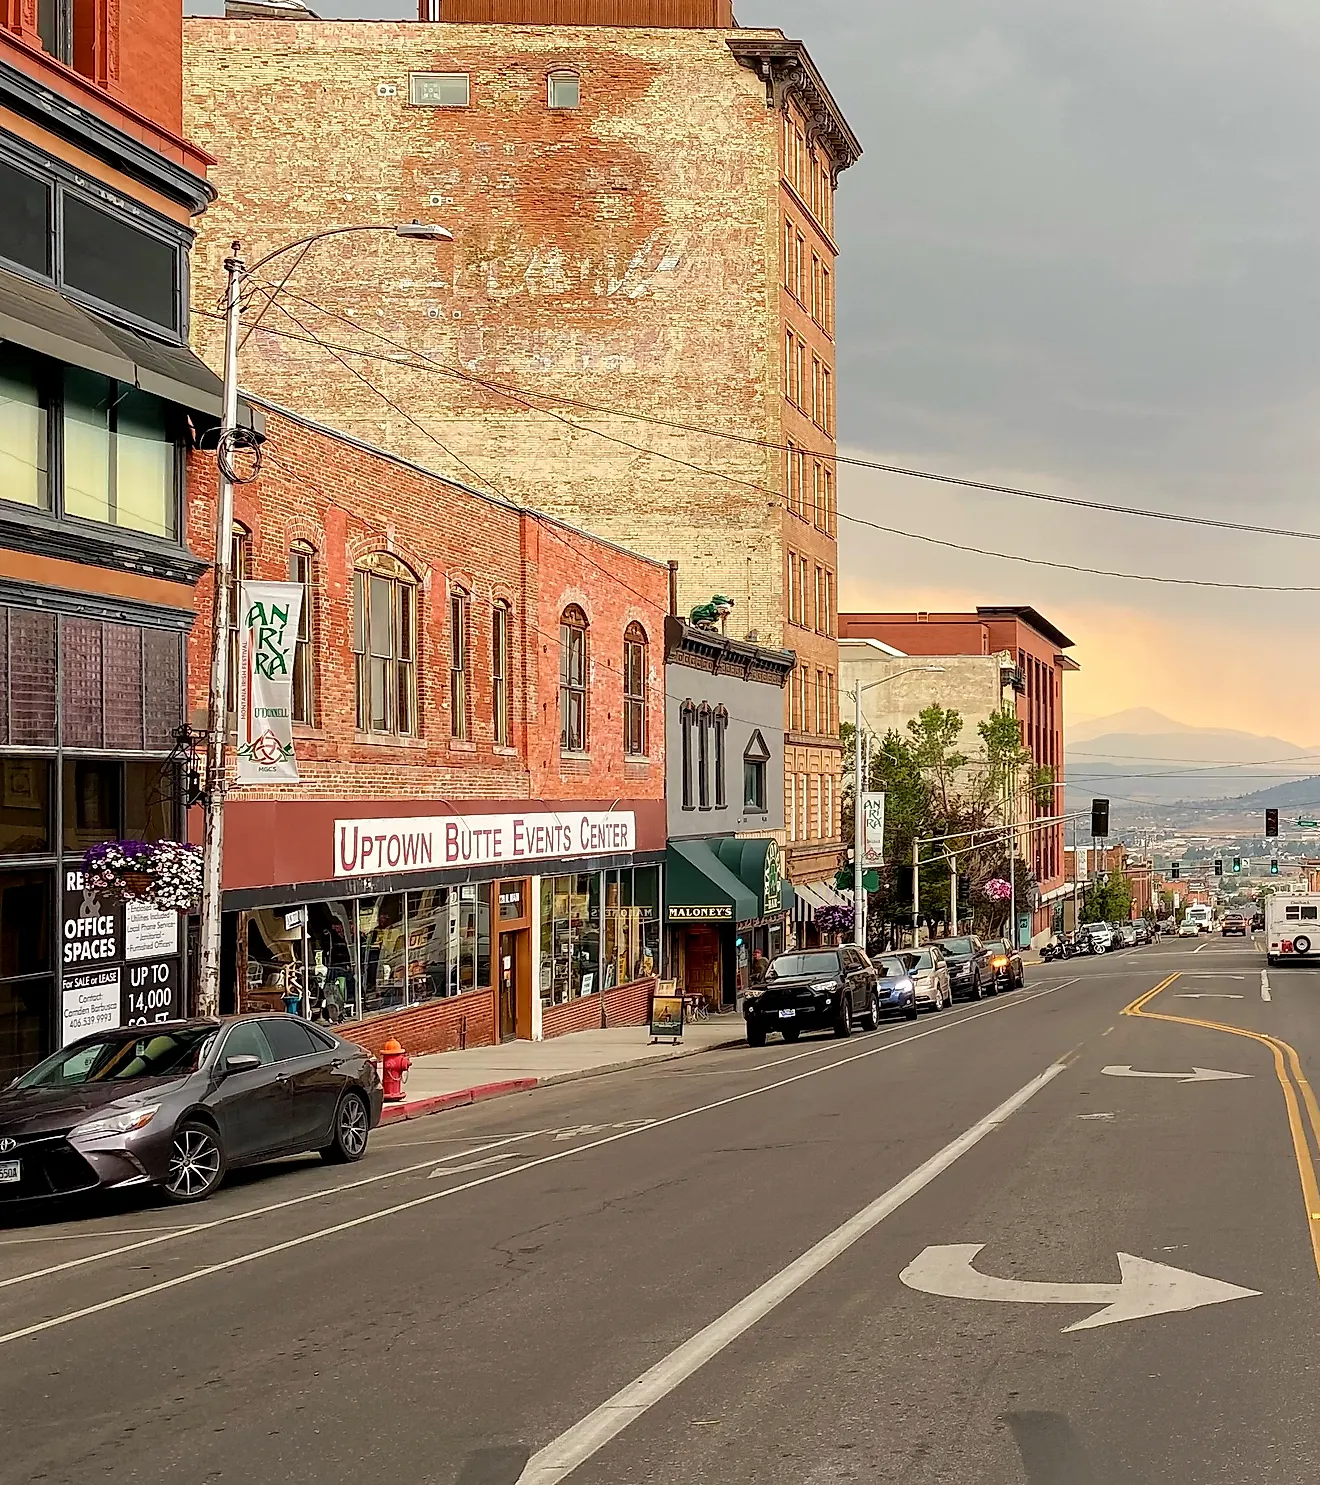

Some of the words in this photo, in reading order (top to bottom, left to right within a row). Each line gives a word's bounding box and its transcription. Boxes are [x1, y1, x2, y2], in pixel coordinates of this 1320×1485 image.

[341, 826, 433, 871] UPTOWN
[446, 823, 502, 862] BUTTE
[512, 820, 571, 856] EVENTS
[580, 816, 628, 849] CENTER
[669, 908, 732, 917] MALONEY'S
[65, 916, 114, 939] OFFICE
[64, 938, 116, 962] SPACES
[63, 980, 74, 989] For
[74, 976, 90, 988] SALE
[99, 972, 117, 983] LEASE
[130, 967, 148, 986] UP
[151, 963, 169, 984] TO
[128, 987, 171, 1013] 14,000
